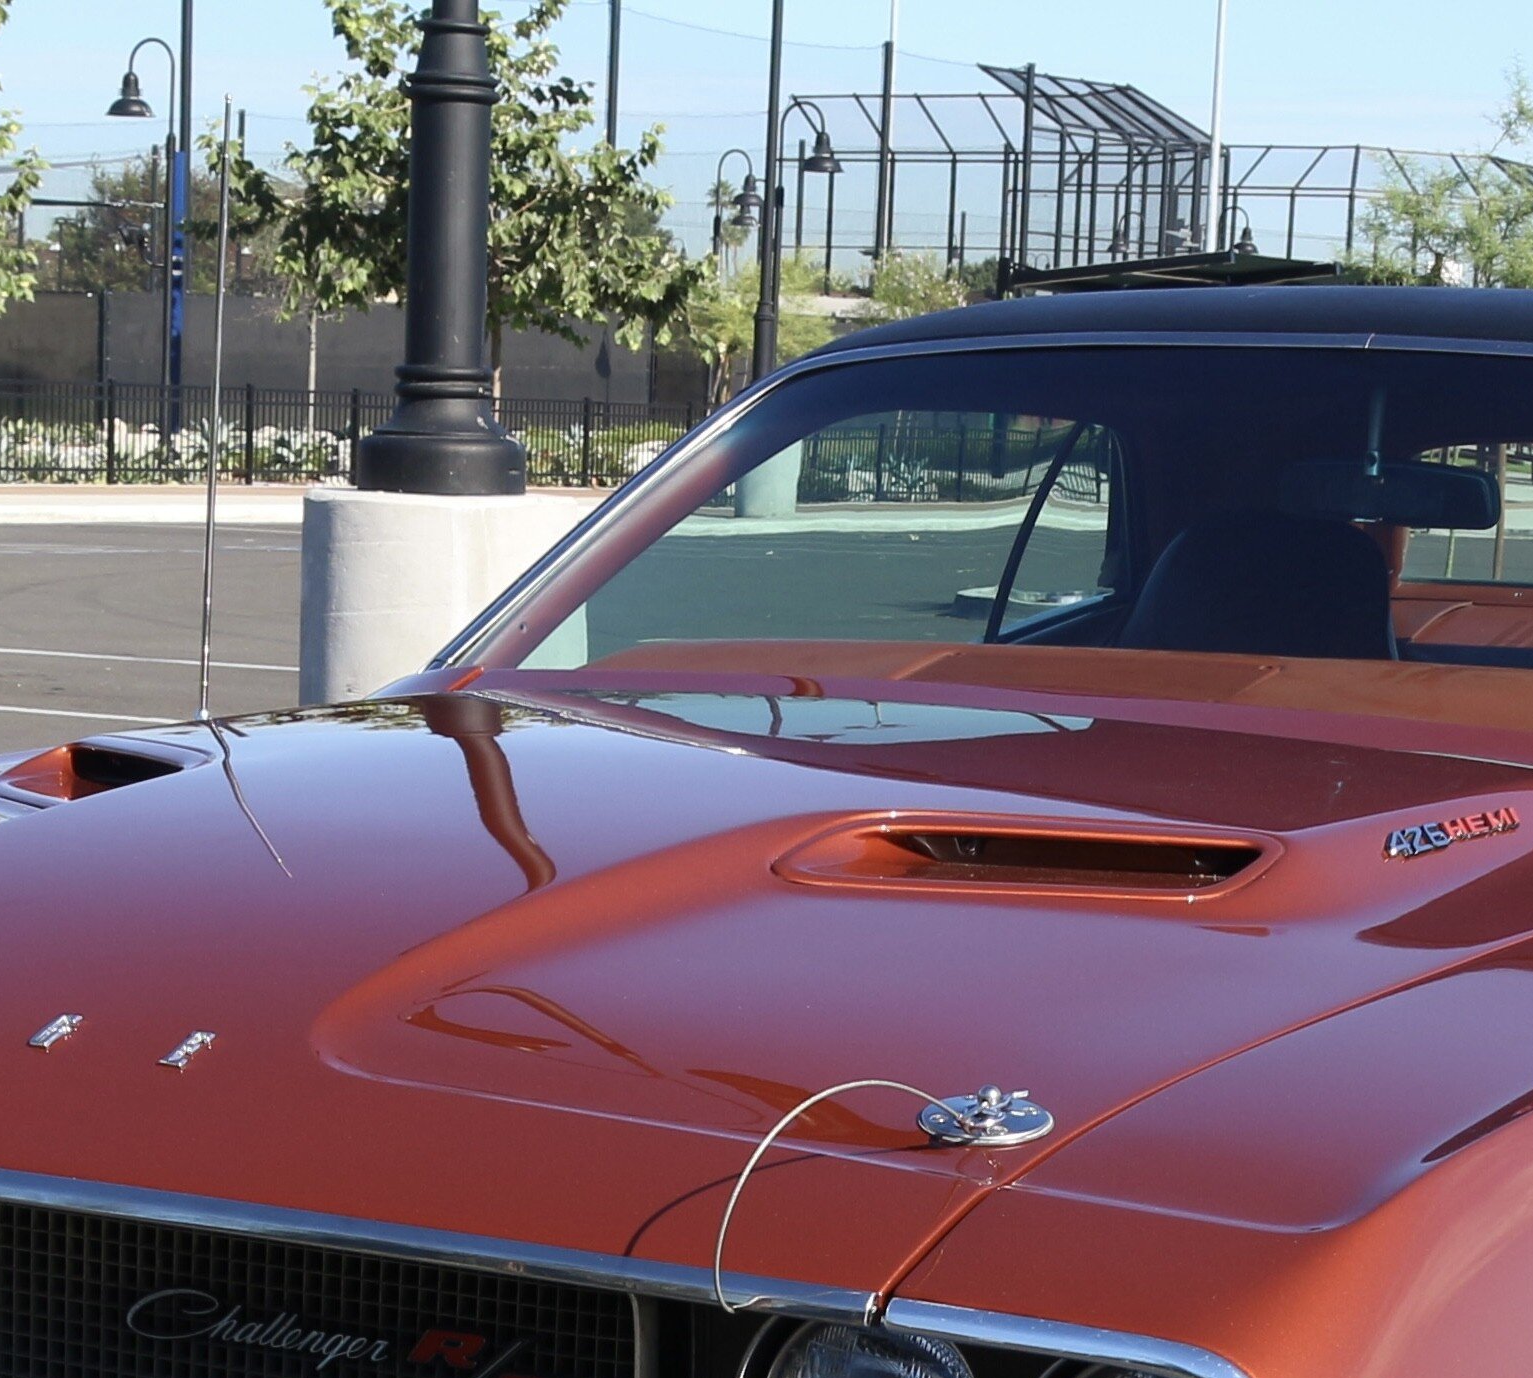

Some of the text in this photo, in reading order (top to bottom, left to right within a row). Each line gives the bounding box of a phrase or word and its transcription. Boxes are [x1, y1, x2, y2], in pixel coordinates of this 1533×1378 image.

[1386, 807, 1520, 858] 426 HEMI
[126, 1288, 389, 1371] Challenger
